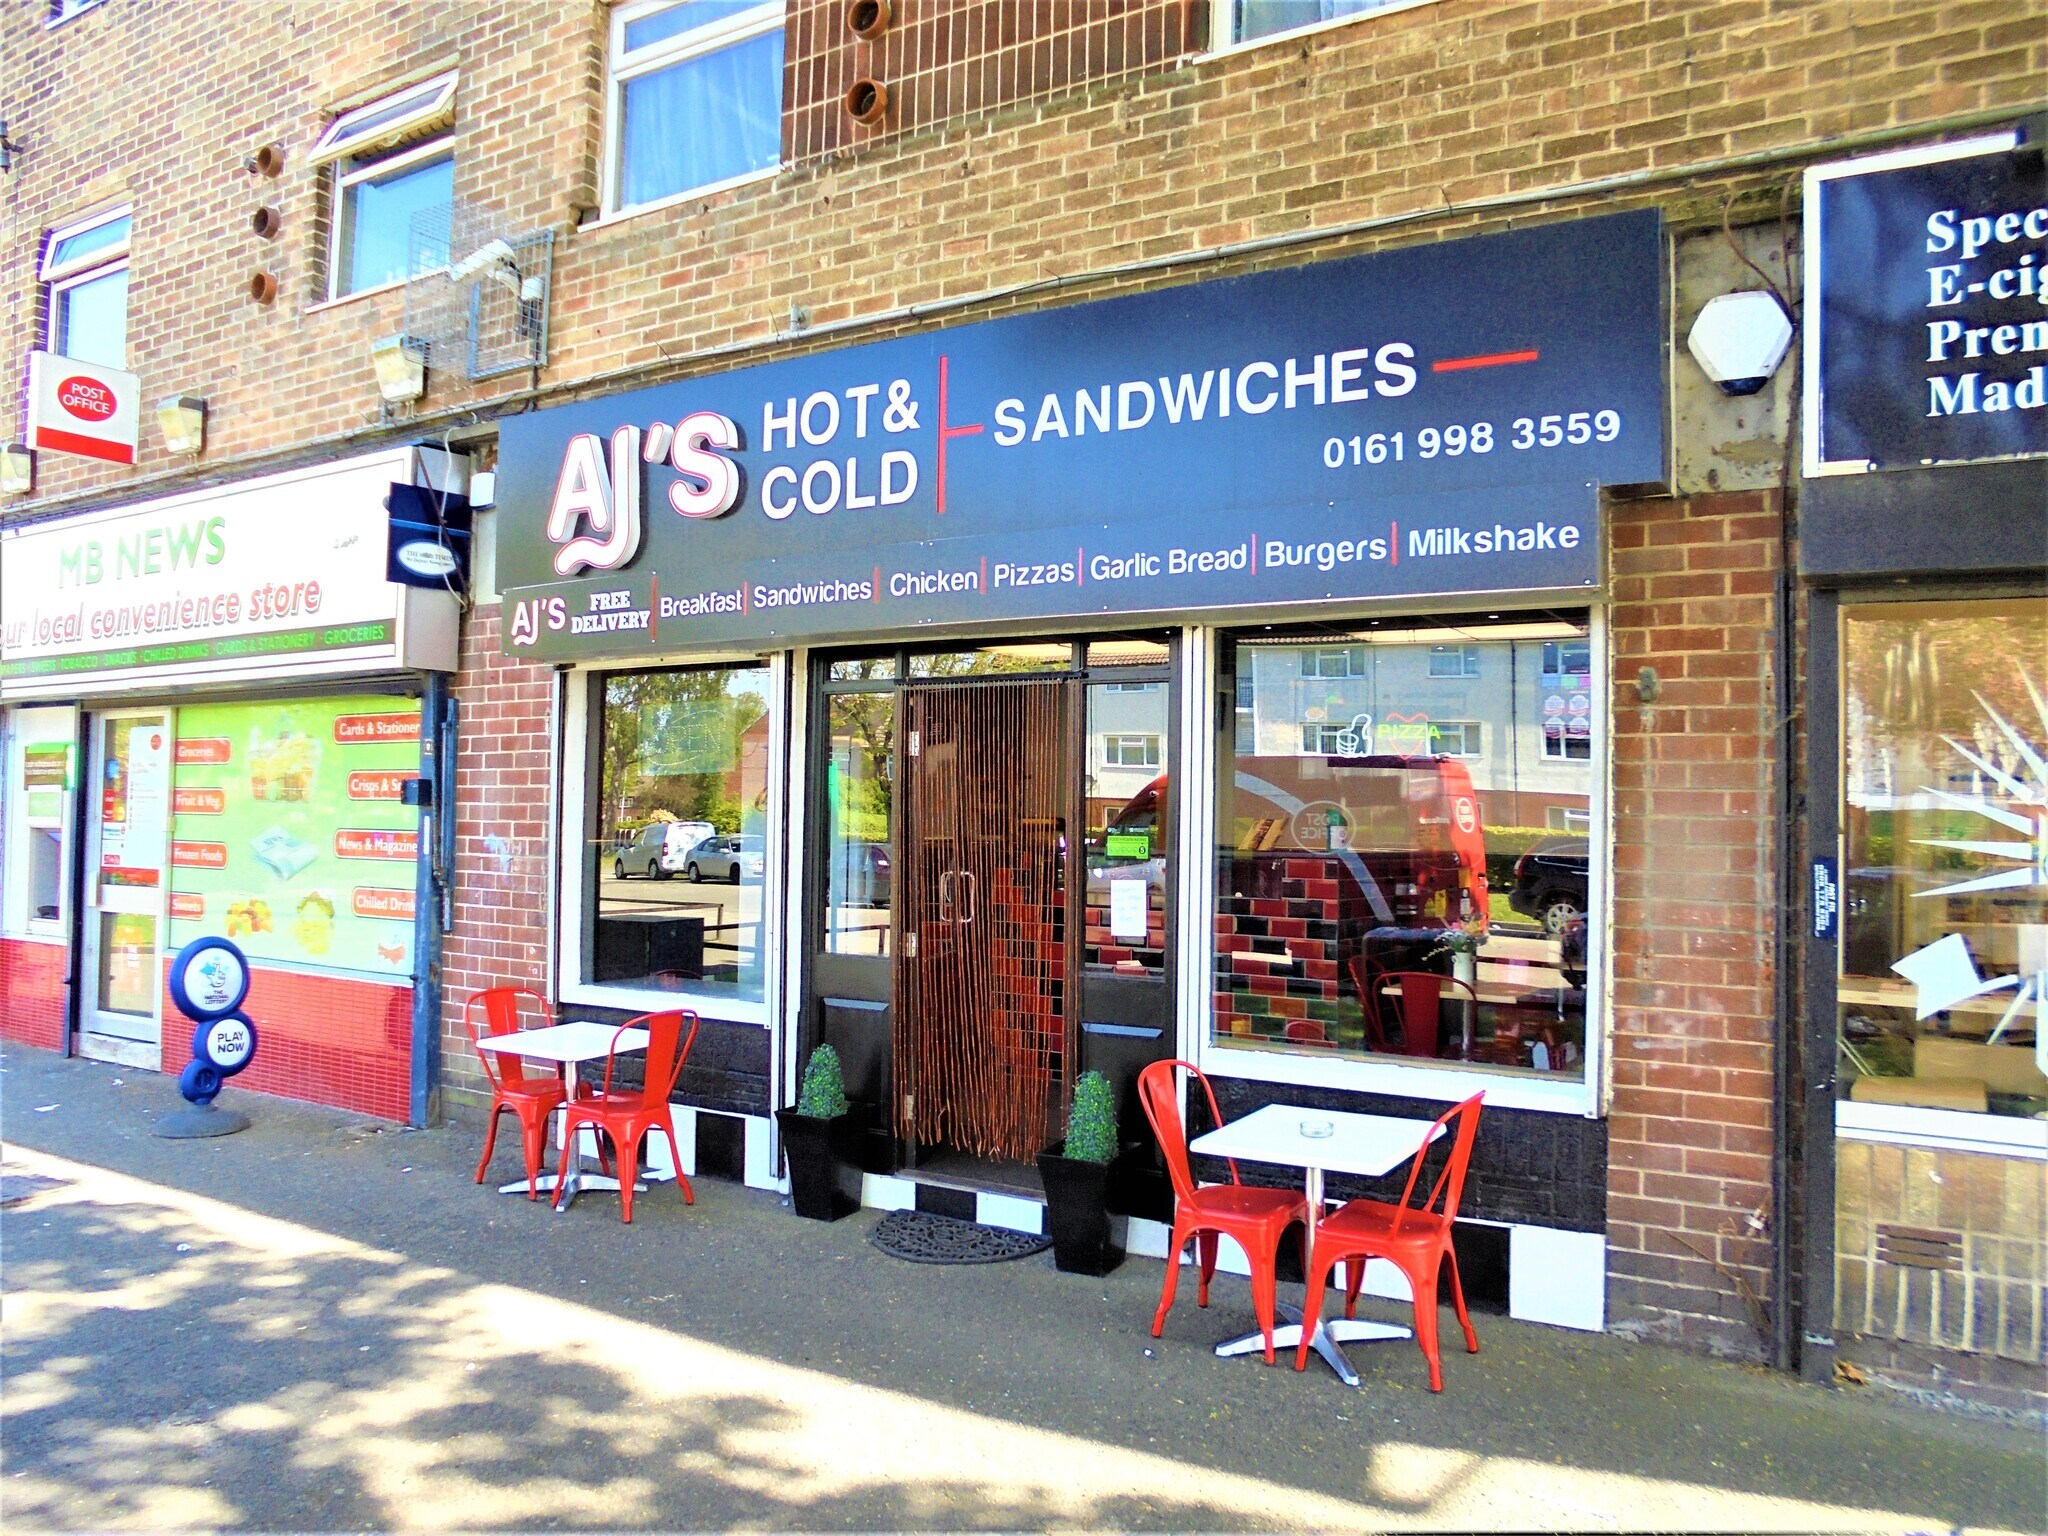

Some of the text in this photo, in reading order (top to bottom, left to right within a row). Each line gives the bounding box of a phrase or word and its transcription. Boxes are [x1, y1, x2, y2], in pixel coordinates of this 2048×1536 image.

[1926, 208, 2048, 259] Spec
[63, 394, 110, 414] OFFICE
[71, 383, 107, 400] POST
[993, 342, 1417, 447] SANDWICHES
[1926, 365, 2048, 417] Mad
[1323, 409, 1621, 468] 0161 998 3559
[547, 411, 740, 575] AJ'S
[761, 450, 919, 520] COLD
[59, 516, 226, 588] MB NEWS
[1408, 522, 1580, 557] Milkshake
[1090, 543, 1247, 581] Garlic Bread
[1265, 537, 1387, 571] Burgers
[889, 569, 978, 597] Chicken
[994, 562, 1075, 588] Pizzas
[589, 590, 631, 612] FREE
[660, 590, 742, 618] Breakfast
[753, 579, 872, 608] Sandwiches
[32, 602, 84, 646] local
[90, 591, 243, 640] convenience
[248, 579, 323, 621] store
[511, 597, 566, 646] AJ'S
[571, 610, 650, 634] DELIVERY
[60, 655, 98, 671] TOBACCO
[104, 651, 137, 667] SNACKS
[143, 646, 176, 662] CHILLED
[178, 643, 209, 659] DRINKS
[216, 640, 247, 656] CARDS
[259, 631, 316, 651] STATIONERY
[324, 624, 385, 645] GROCERIES
[339, 722, 365, 736] Cards
[367, 721, 375, 735] &
[1377, 723, 1441, 740] PIZZA
[178, 746, 215, 757] Groceries
[175, 793, 196, 806] Fruit
[198, 794, 205, 806] &
[351, 778, 380, 796] Crisps
[381, 778, 389, 792] &
[174, 847, 224, 862] Frozen Foods
[338, 837, 364, 850] News
[365, 837, 373, 850] &
[172, 899, 202, 912] Sweets
[356, 894, 389, 911] Chilled
[217, 1031, 244, 1043] PLAY
[217, 1042, 245, 1054] NOW
